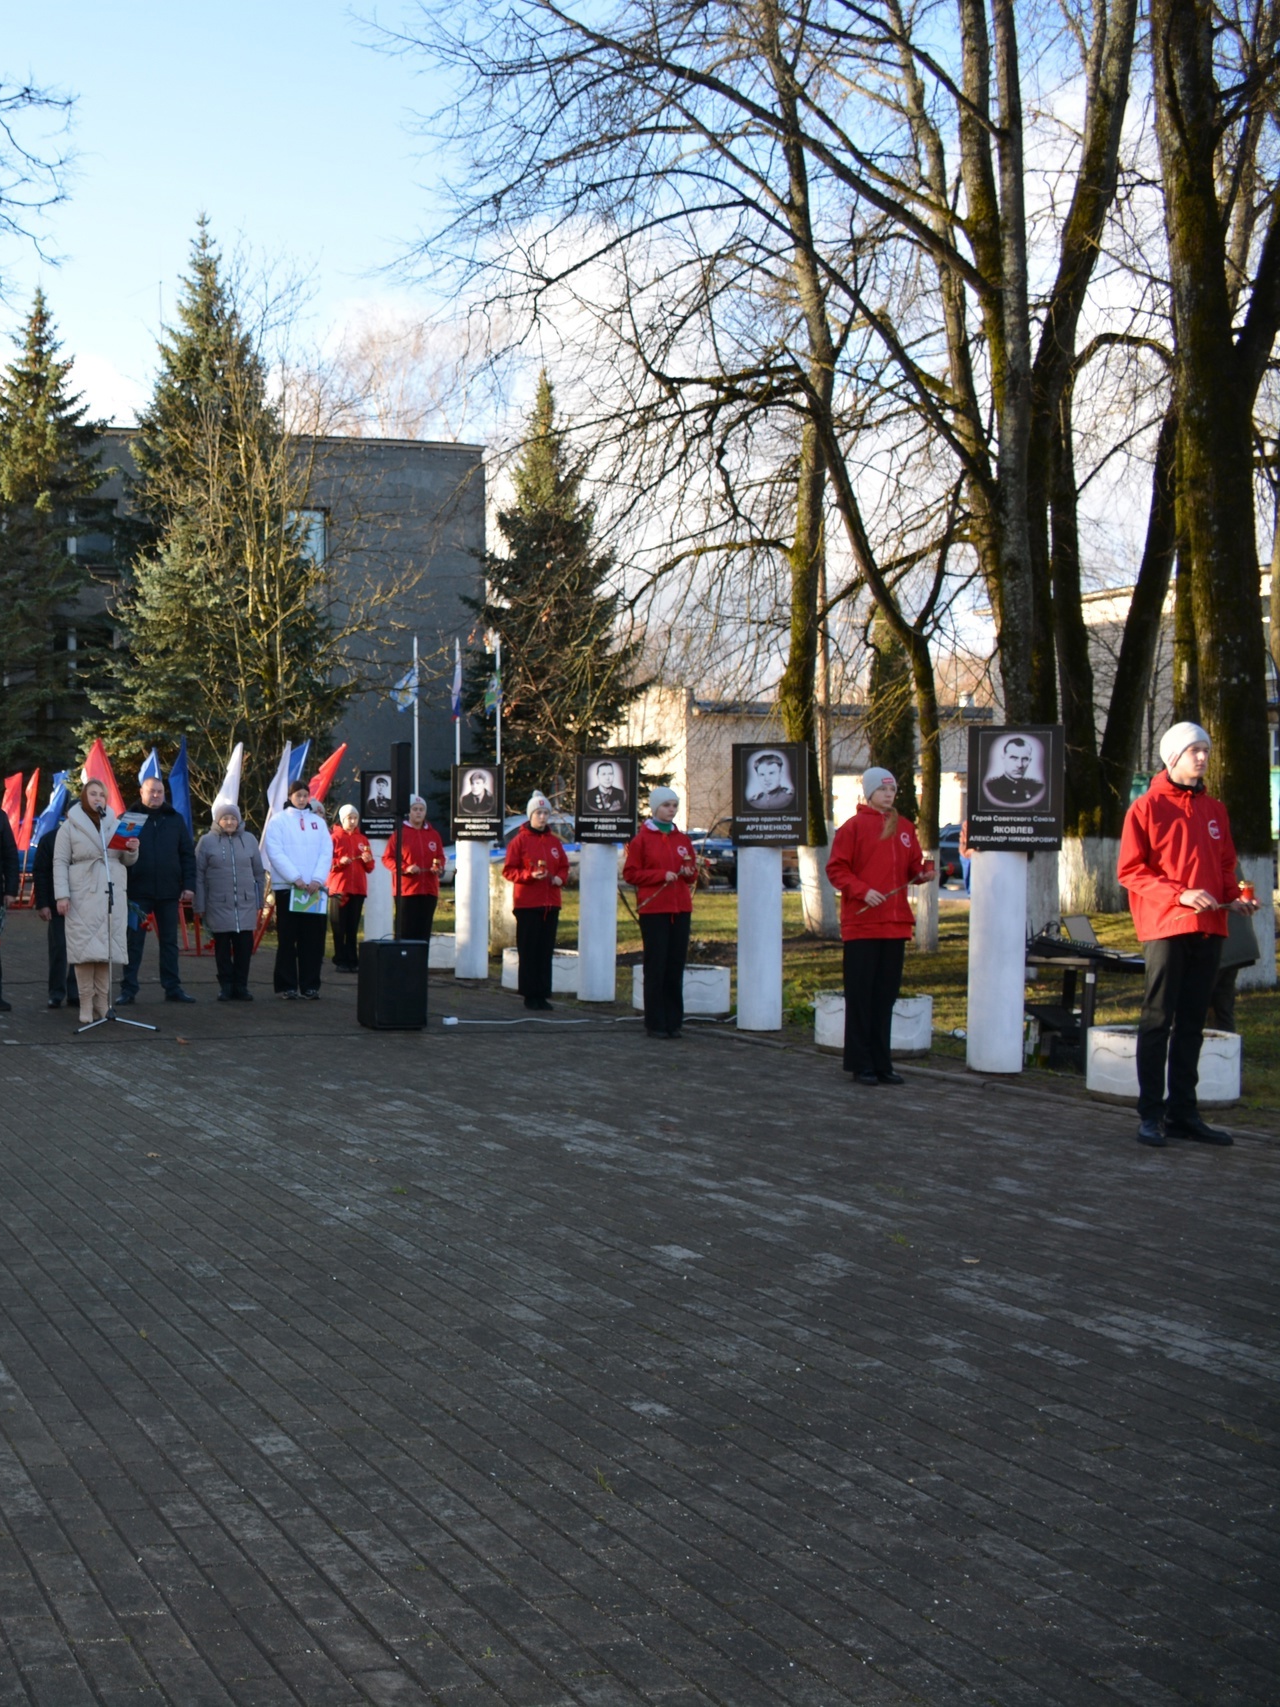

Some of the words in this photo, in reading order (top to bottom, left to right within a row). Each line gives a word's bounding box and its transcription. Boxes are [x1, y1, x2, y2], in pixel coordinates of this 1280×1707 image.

[971, 814, 992, 822] Герой
[992, 815, 1032, 823] Советского
[1033, 815, 1056, 823] Союза
[992, 826, 1034, 834] ЯКОВЛЕВ
[969, 835, 1007, 843] АЛЕКСАНДР
